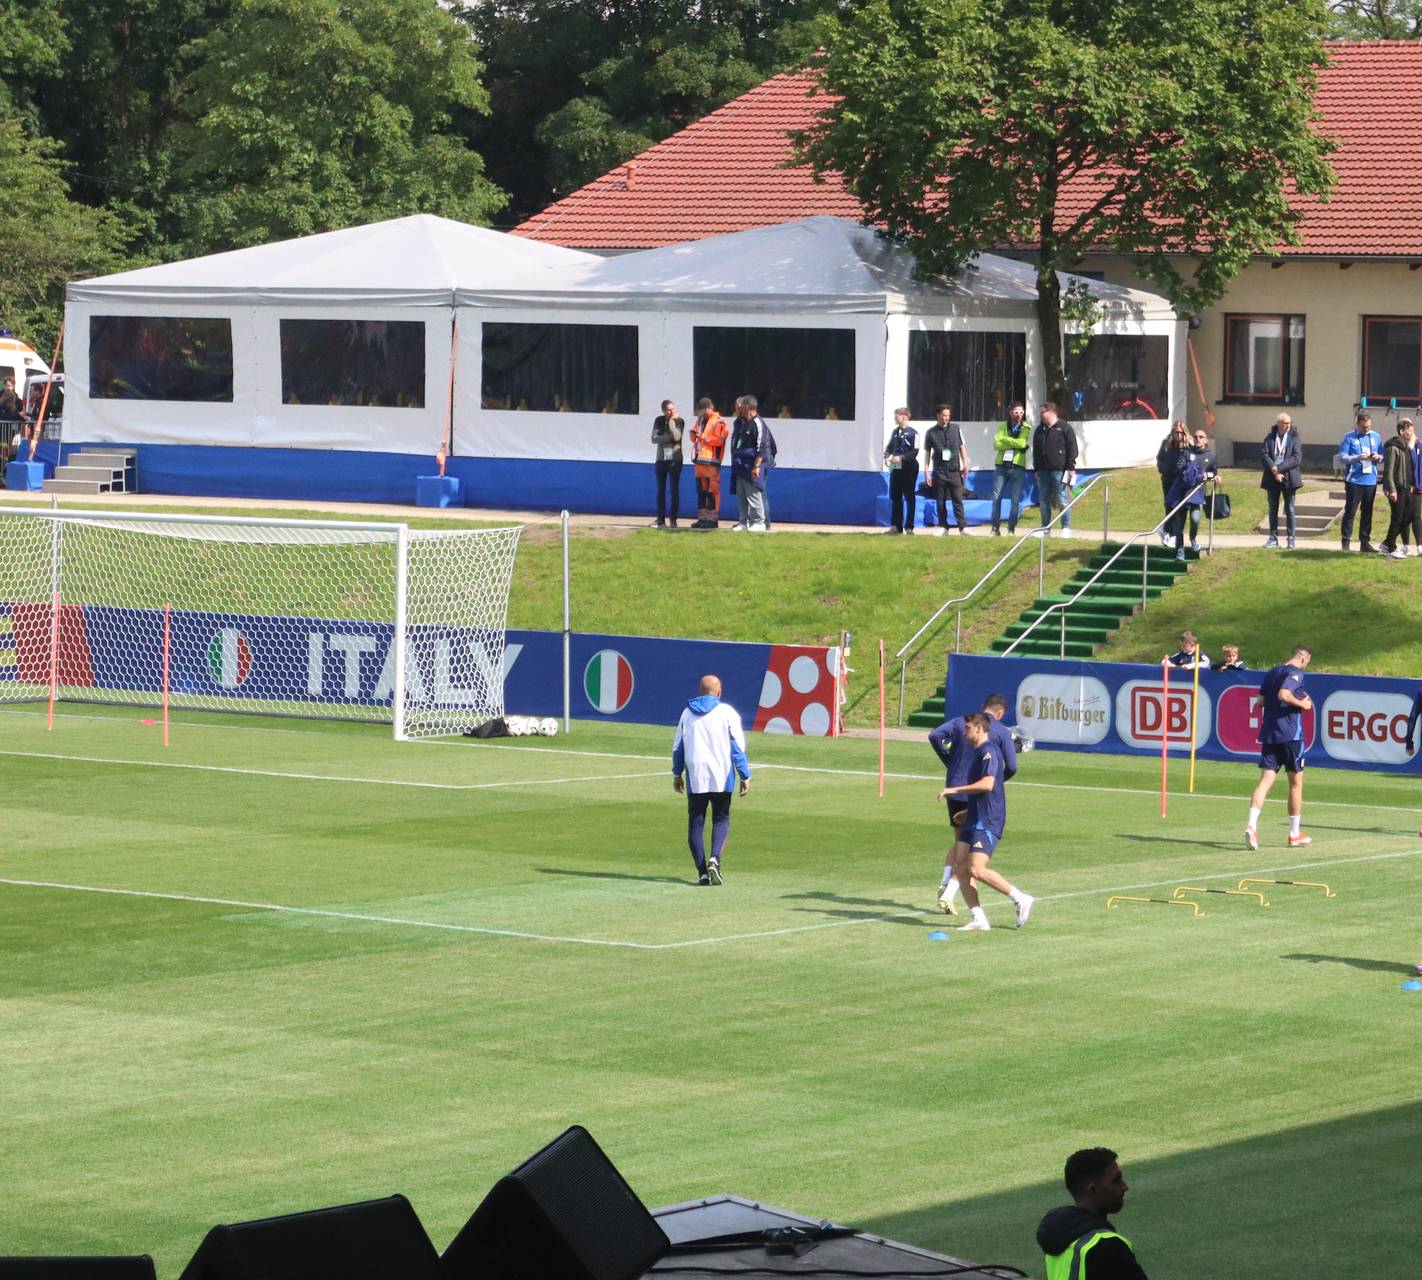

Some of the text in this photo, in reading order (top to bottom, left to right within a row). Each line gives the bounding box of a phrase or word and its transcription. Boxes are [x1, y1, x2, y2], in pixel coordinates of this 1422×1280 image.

[307, 632, 524, 706] ITALY
[1139, 695, 1188, 733] DB
[1328, 710, 1410, 744] ERGO
